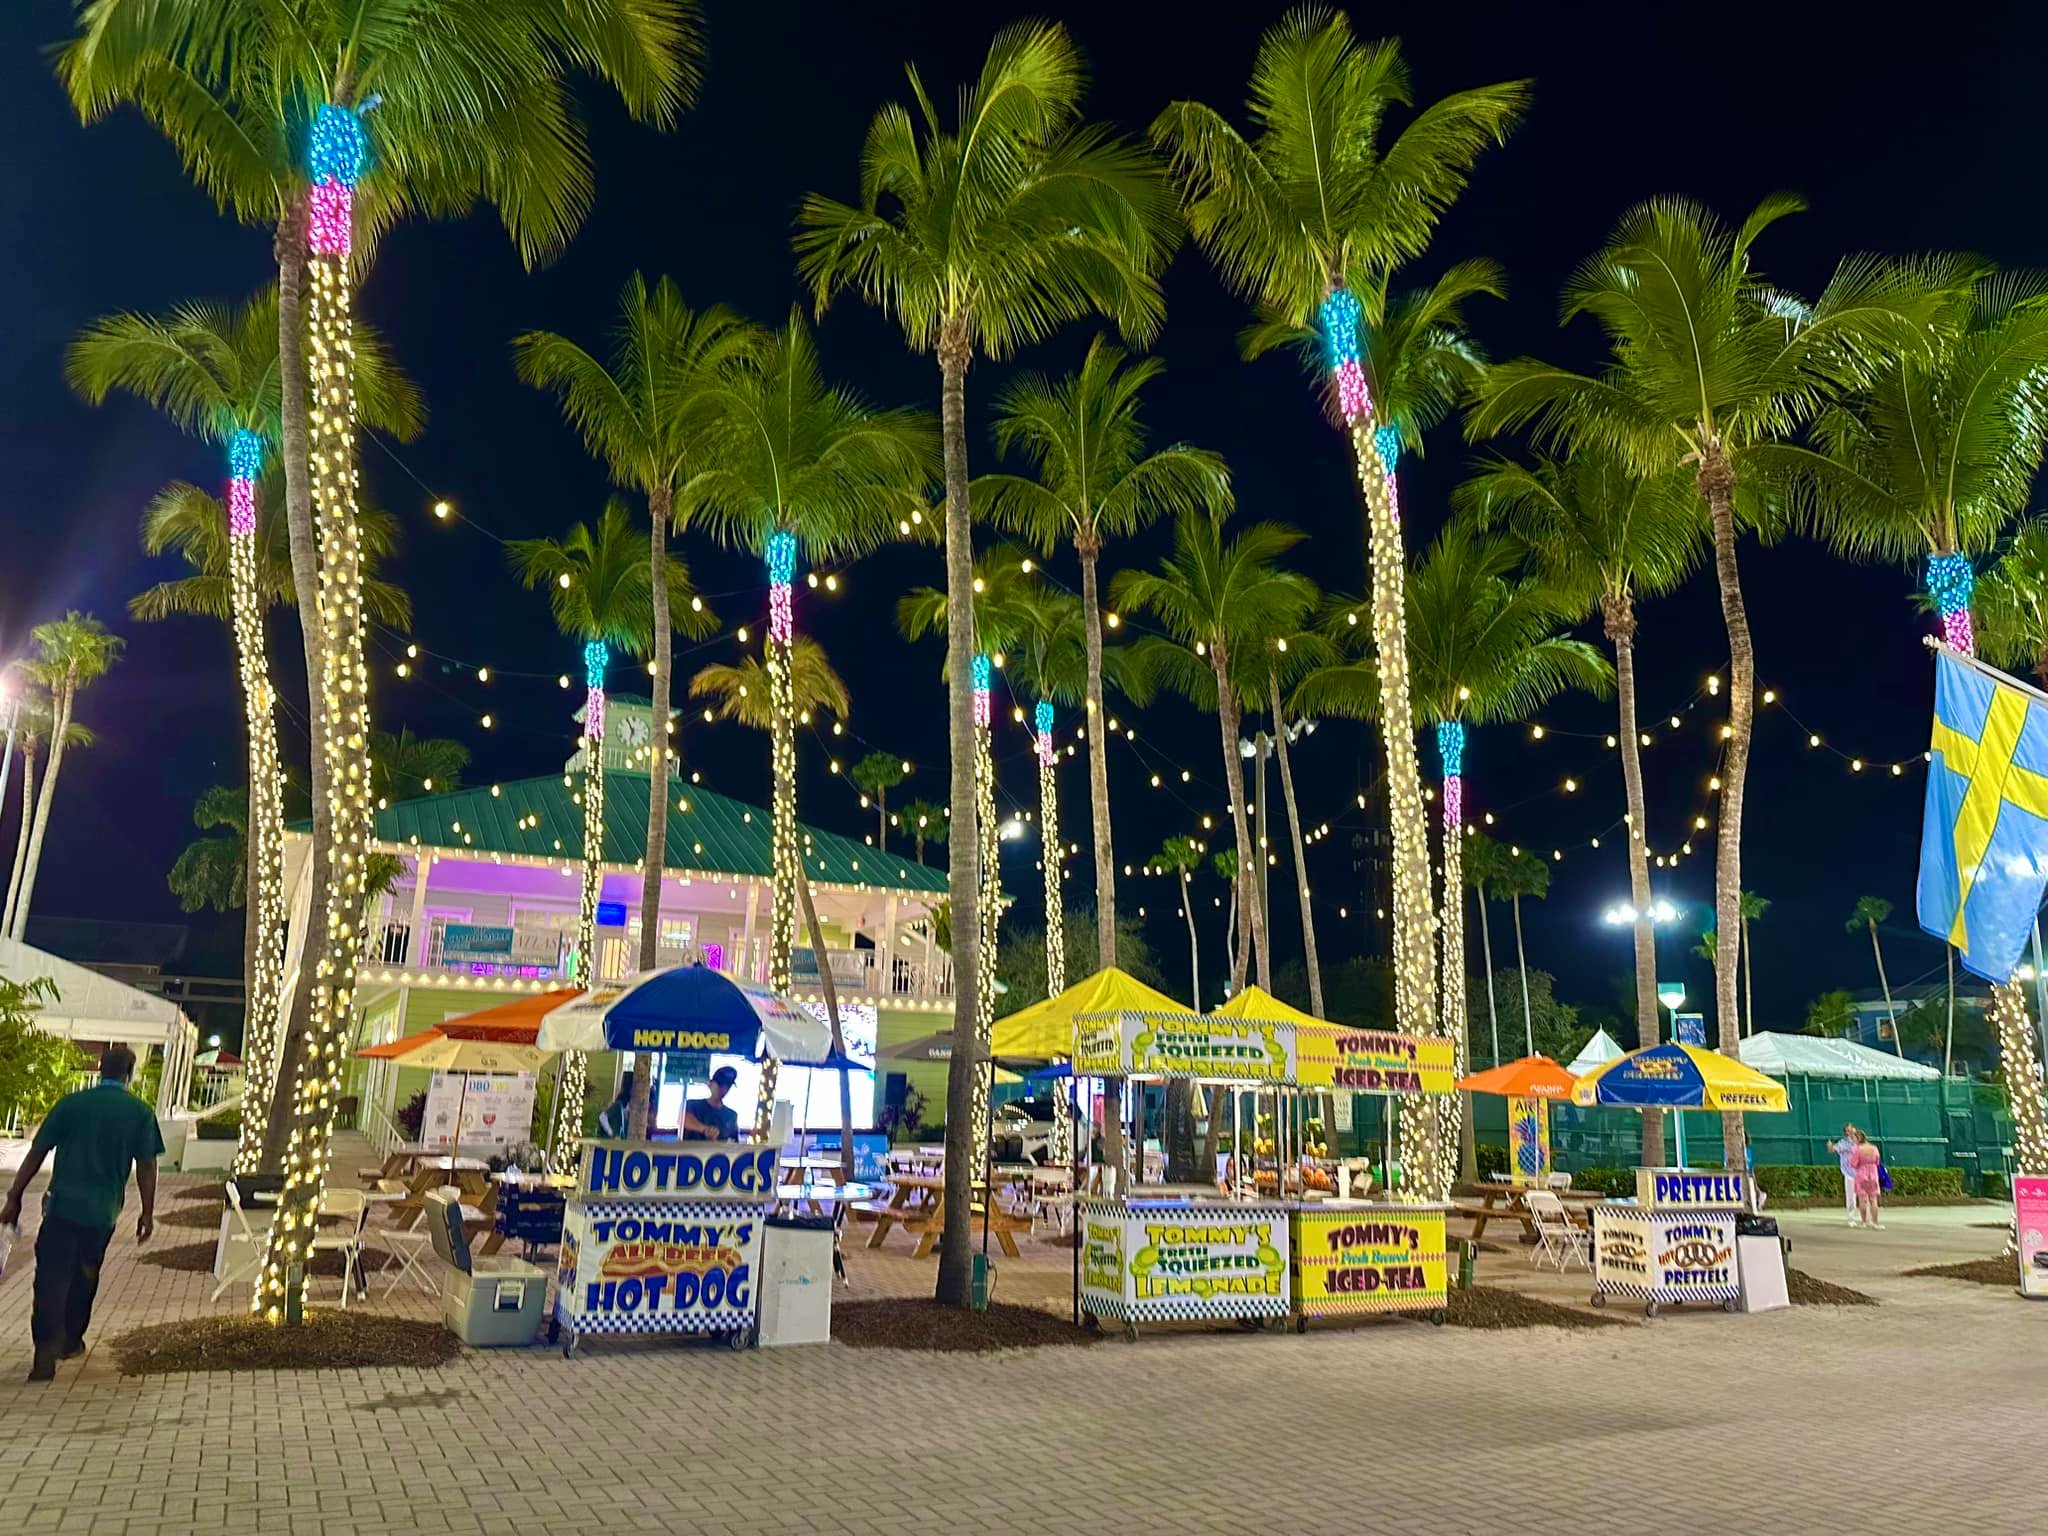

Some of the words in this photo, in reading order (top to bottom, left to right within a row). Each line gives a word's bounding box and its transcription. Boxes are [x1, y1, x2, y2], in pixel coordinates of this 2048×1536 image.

[1143, 1016, 1276, 1040] TOMMY'S
[1156, 1033, 1209, 1043] FRESH
[633, 1029, 676, 1047] HOT
[677, 1030, 730, 1049] DOGS
[1335, 1037, 1417, 1060] TOMMY'S
[1155, 1043, 1265, 1059] SQUEEZED
[1133, 1055, 1286, 1078] LEMONADE
[1347, 1054, 1371, 1067] Fresh
[1374, 1056, 1408, 1069] Brewed
[1332, 1067, 1422, 1092] ICED-TEA
[1720, 1093, 1767, 1105] PRETZELS
[1655, 1175, 1743, 1203] PRETZELS
[593, 1219, 754, 1248] TOMMY'S
[1145, 1223, 1272, 1247] TOMMY'S
[1327, 1224, 1420, 1251] TOMMY'S
[1602, 1230, 1644, 1246] TOMMY'S
[1664, 1224, 1724, 1244] TOMMY'S
[611, 1243, 655, 1260] ALL
[665, 1246, 734, 1262] BEEF
[1157, 1247, 1209, 1257] FRESH
[1341, 1250, 1370, 1265] Fresh
[1371, 1249, 1410, 1264] Brewed
[1658, 1249, 1676, 1265] HOT
[1156, 1255, 1261, 1274] SQUEEZED
[1602, 1256, 1647, 1273] PRETZELS
[1135, 1271, 1281, 1299] LEMONADE
[1323, 1266, 1427, 1293] ICED-TEA
[1664, 1268, 1729, 1285] PRETZELS
[586, 1274, 668, 1312] HOT
[674, 1265, 750, 1311] DOG
